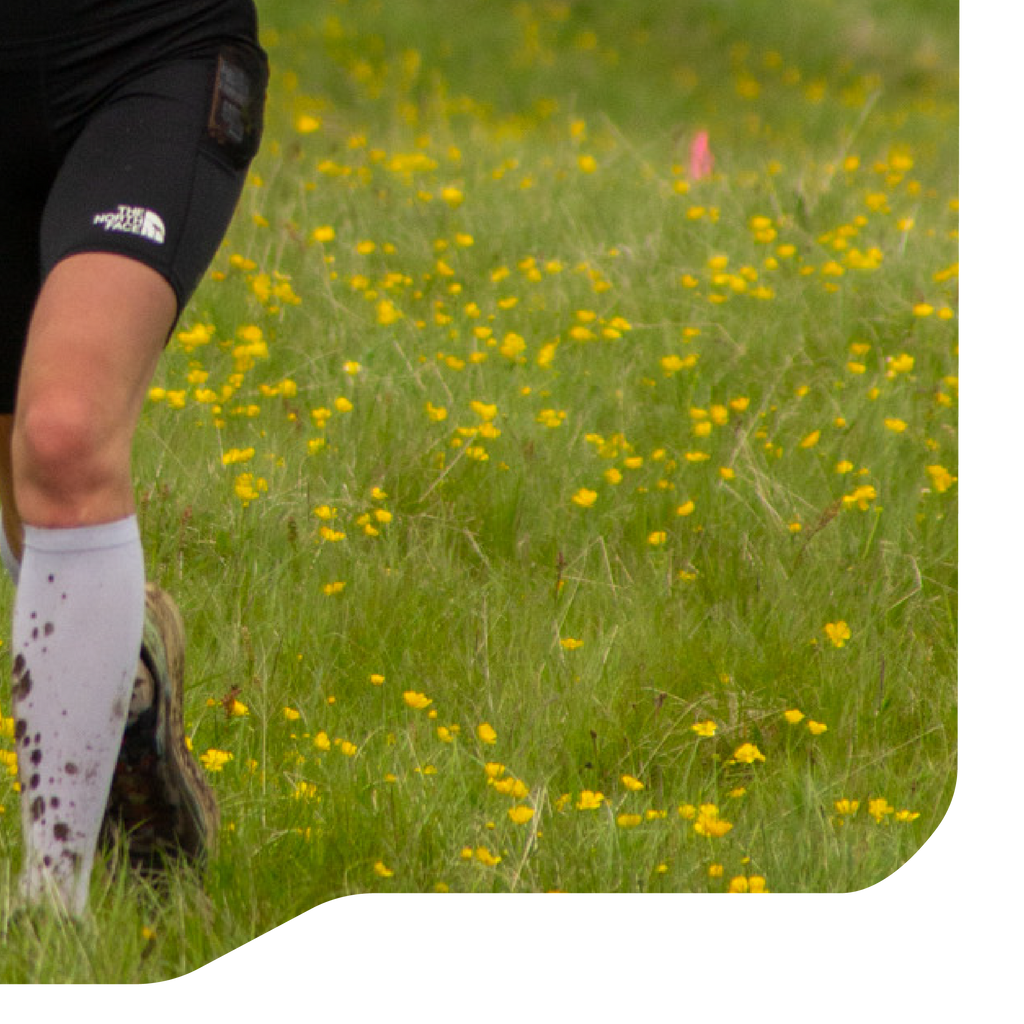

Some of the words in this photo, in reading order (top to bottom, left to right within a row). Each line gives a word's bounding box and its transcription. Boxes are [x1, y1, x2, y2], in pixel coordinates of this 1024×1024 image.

[117, 204, 145, 217] THE
[93, 212, 144, 226] NORTH
[104, 221, 142, 235] FACE
